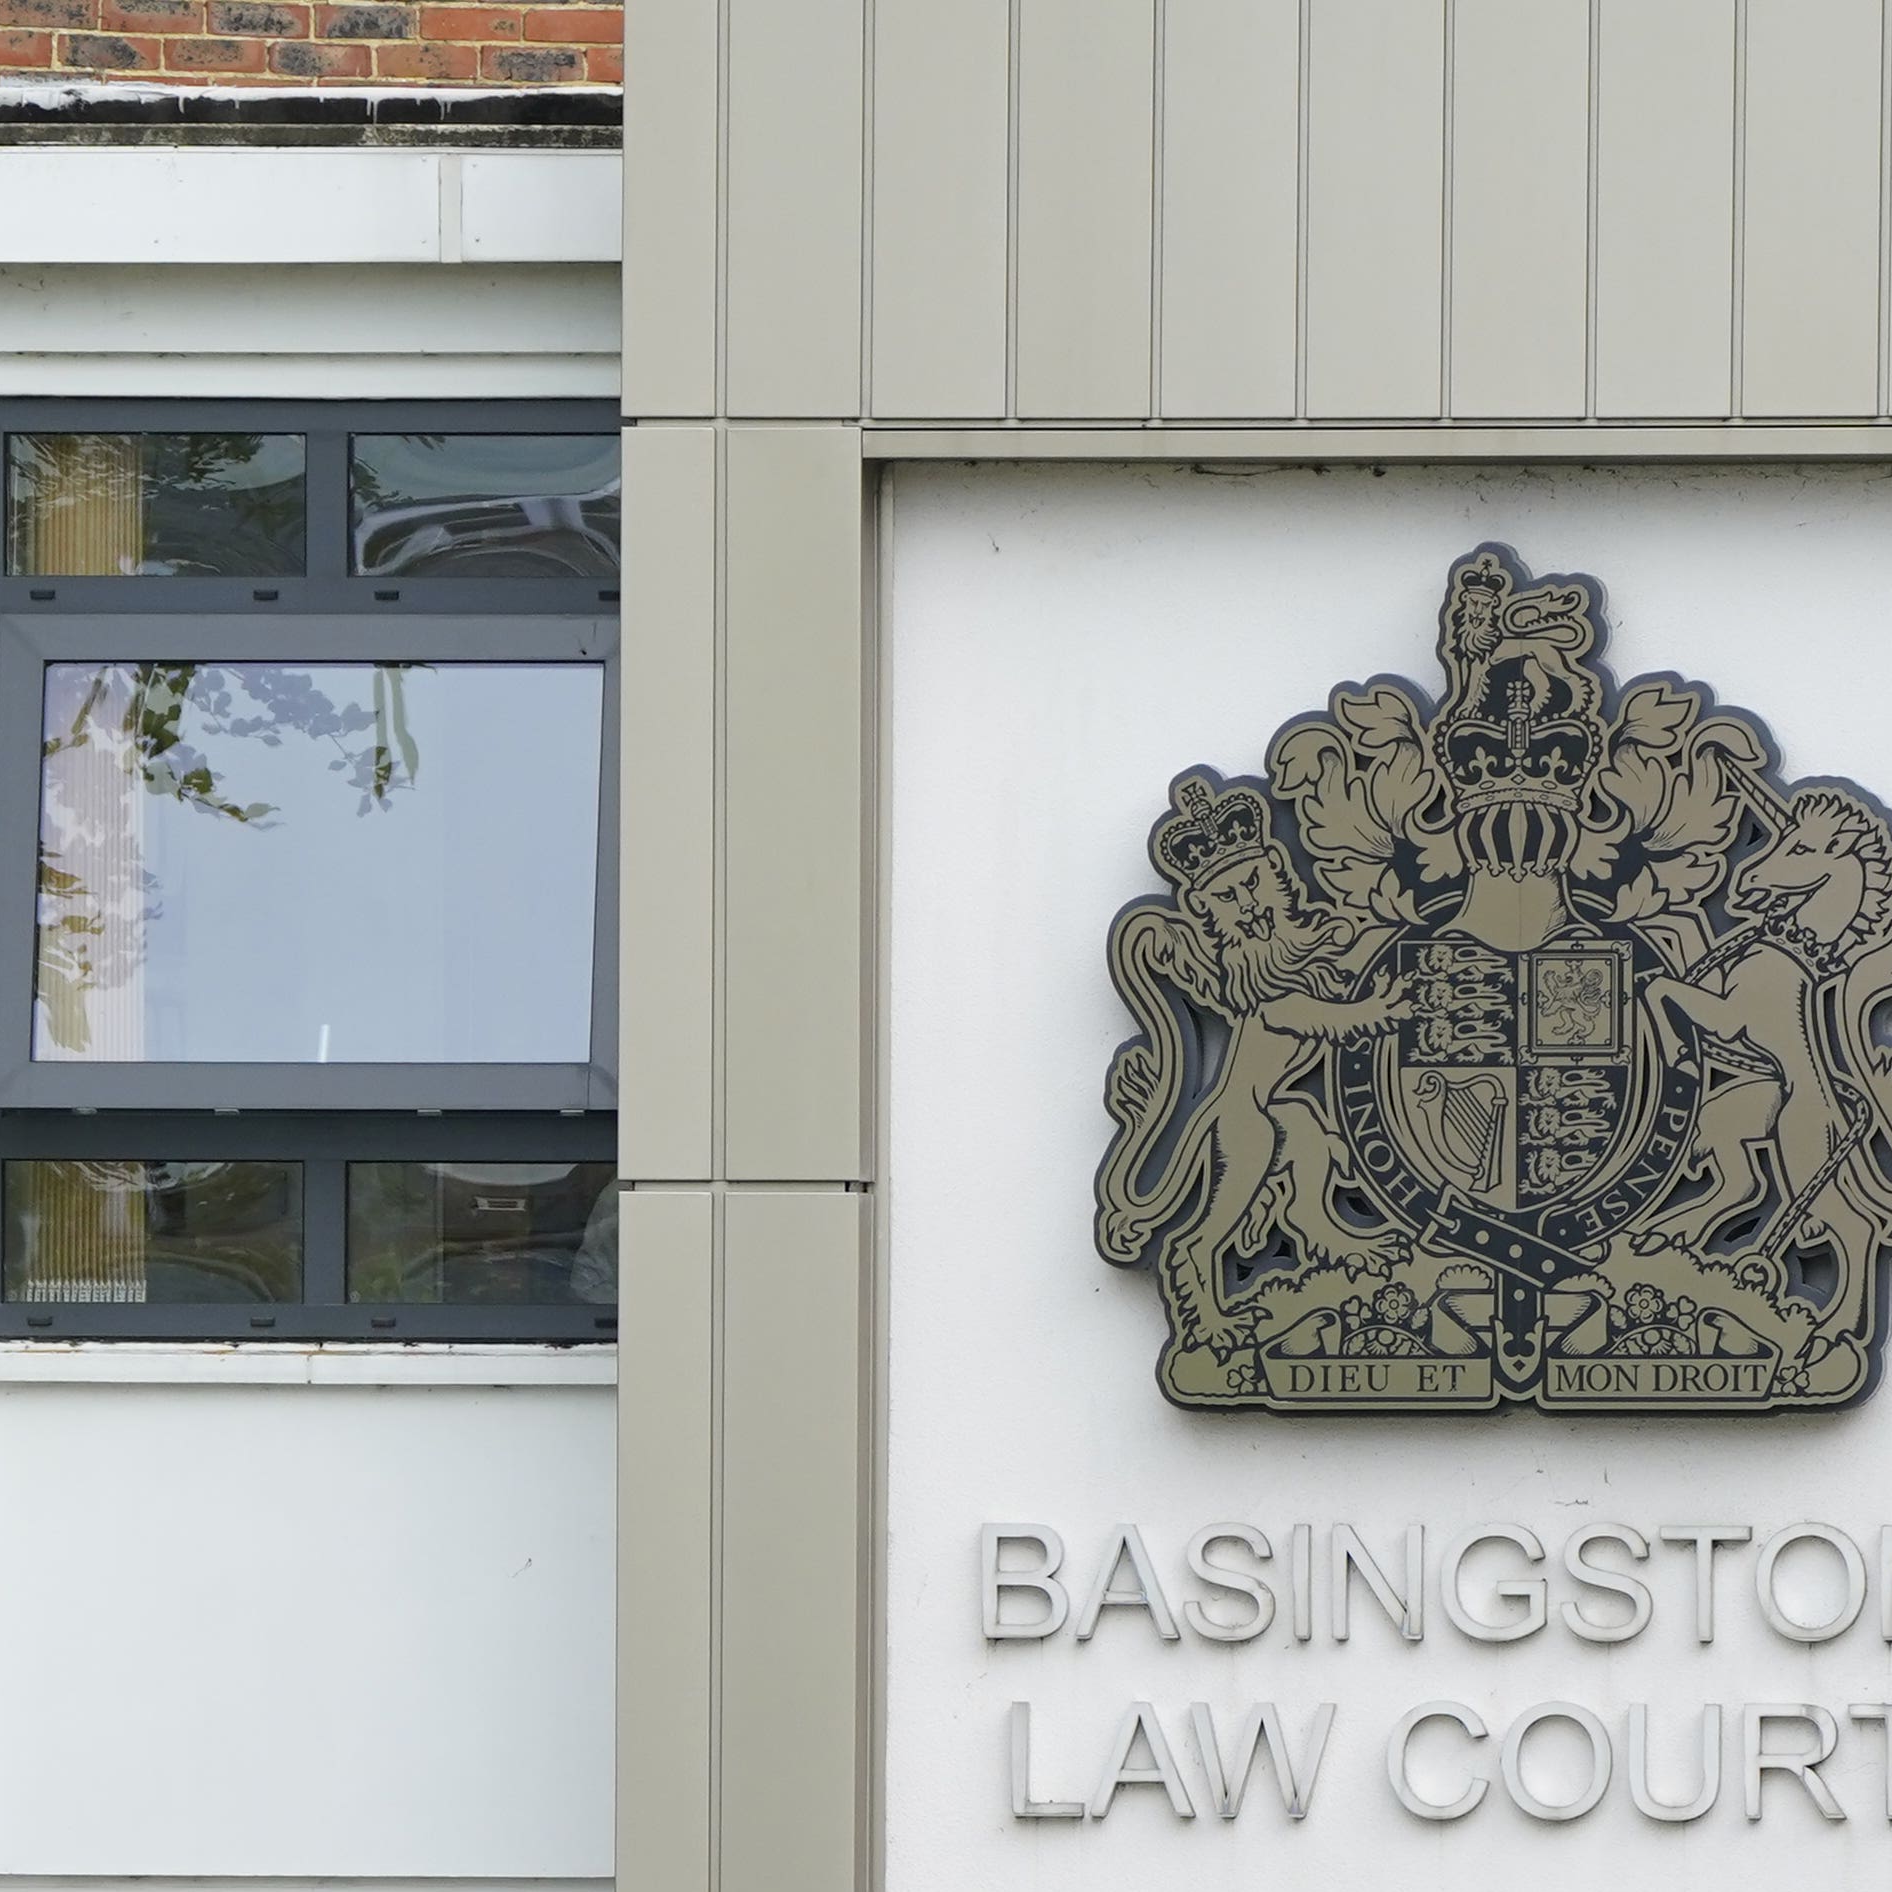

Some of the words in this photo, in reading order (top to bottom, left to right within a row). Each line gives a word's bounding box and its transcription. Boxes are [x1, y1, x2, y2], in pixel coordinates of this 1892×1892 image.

[1345, 1080, 1424, 1206] HONI
[1575, 1103, 1690, 1237] PENSE
[1289, 1364, 1391, 1393] DIEU
[1418, 1364, 1466, 1392] ET
[1556, 1363, 1641, 1393] MON
[1651, 1363, 1768, 1393] DROIT
[1009, 1700, 1337, 1820] LAW
